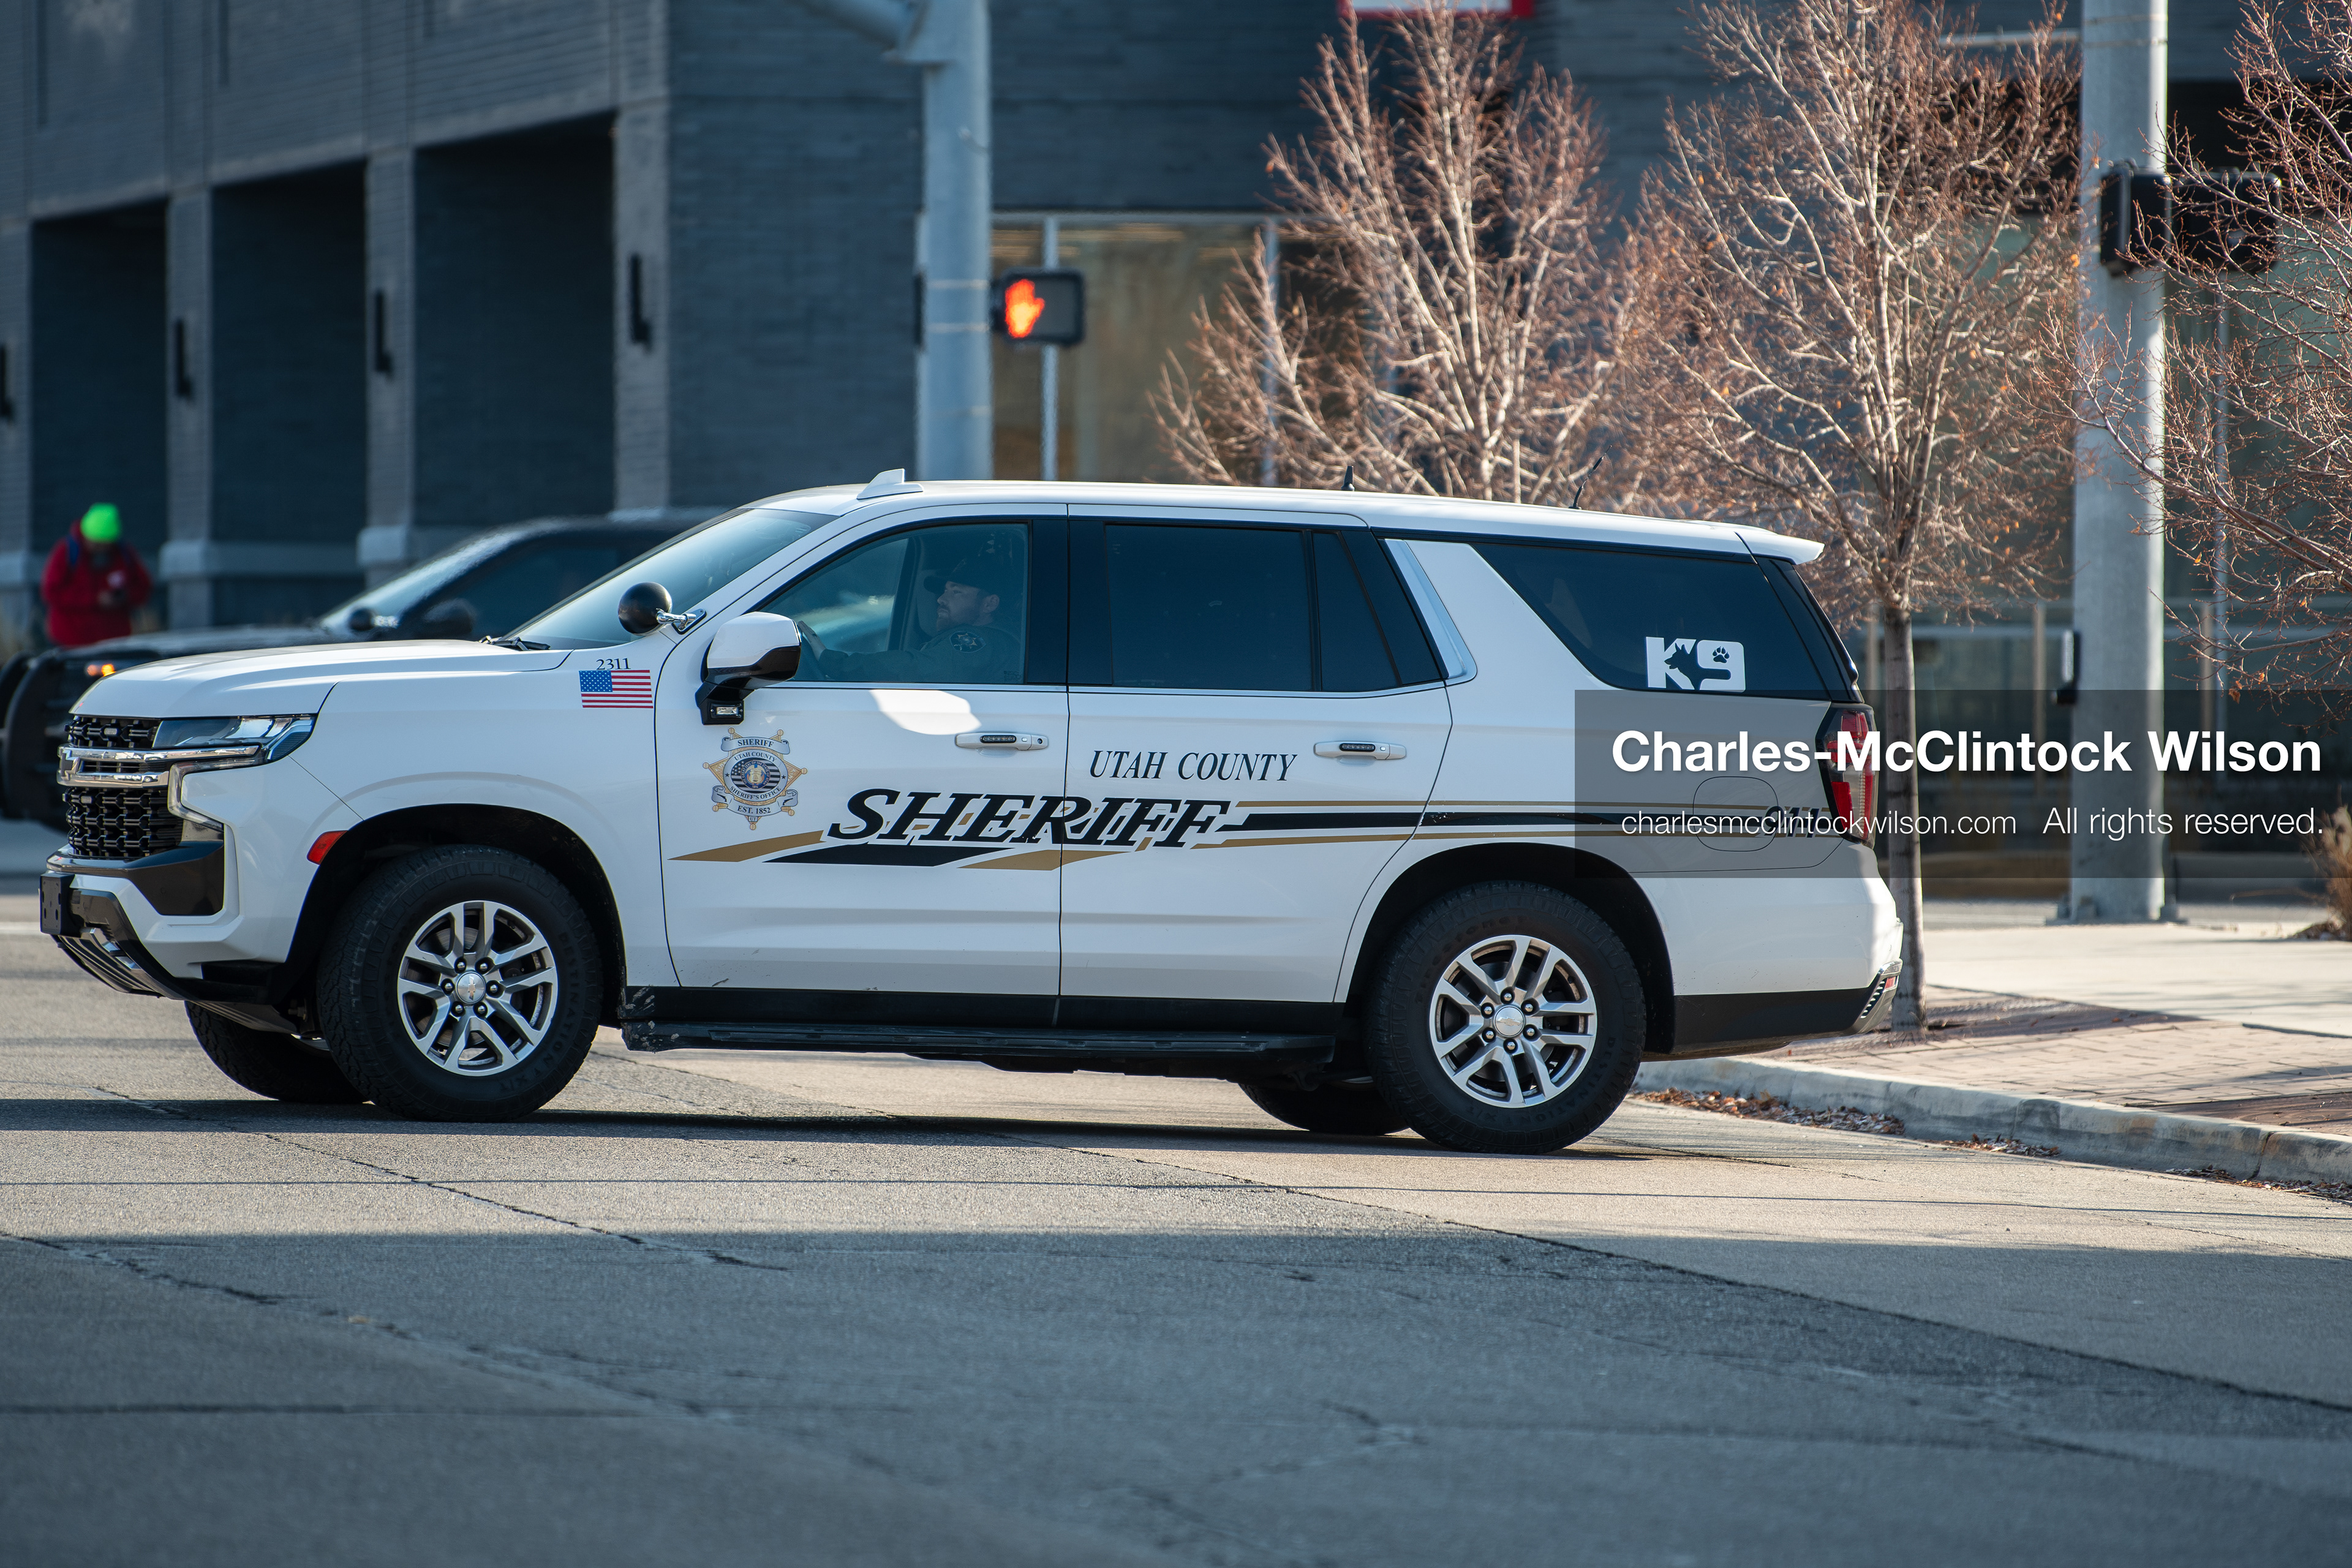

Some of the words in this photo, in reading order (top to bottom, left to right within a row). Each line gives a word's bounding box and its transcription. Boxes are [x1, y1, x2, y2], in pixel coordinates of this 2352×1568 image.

[596, 657, 631, 670] 2311
[1646, 636, 1746, 693] K9
[737, 739, 774, 747] SHERIFF
[734, 752, 750, 761] UTAH
[751, 751, 777, 762] COUNTY
[1090, 750, 1168, 780] UTAH
[1178, 752, 1298, 782] COUNTY
[729, 786, 760, 800] SHERIFF'S
[760, 786, 782, 799] OFFICE
[737, 805, 753, 814] EST.
[827, 788, 1231, 850] SHERIFF
[1764, 805, 1820, 839] 911
